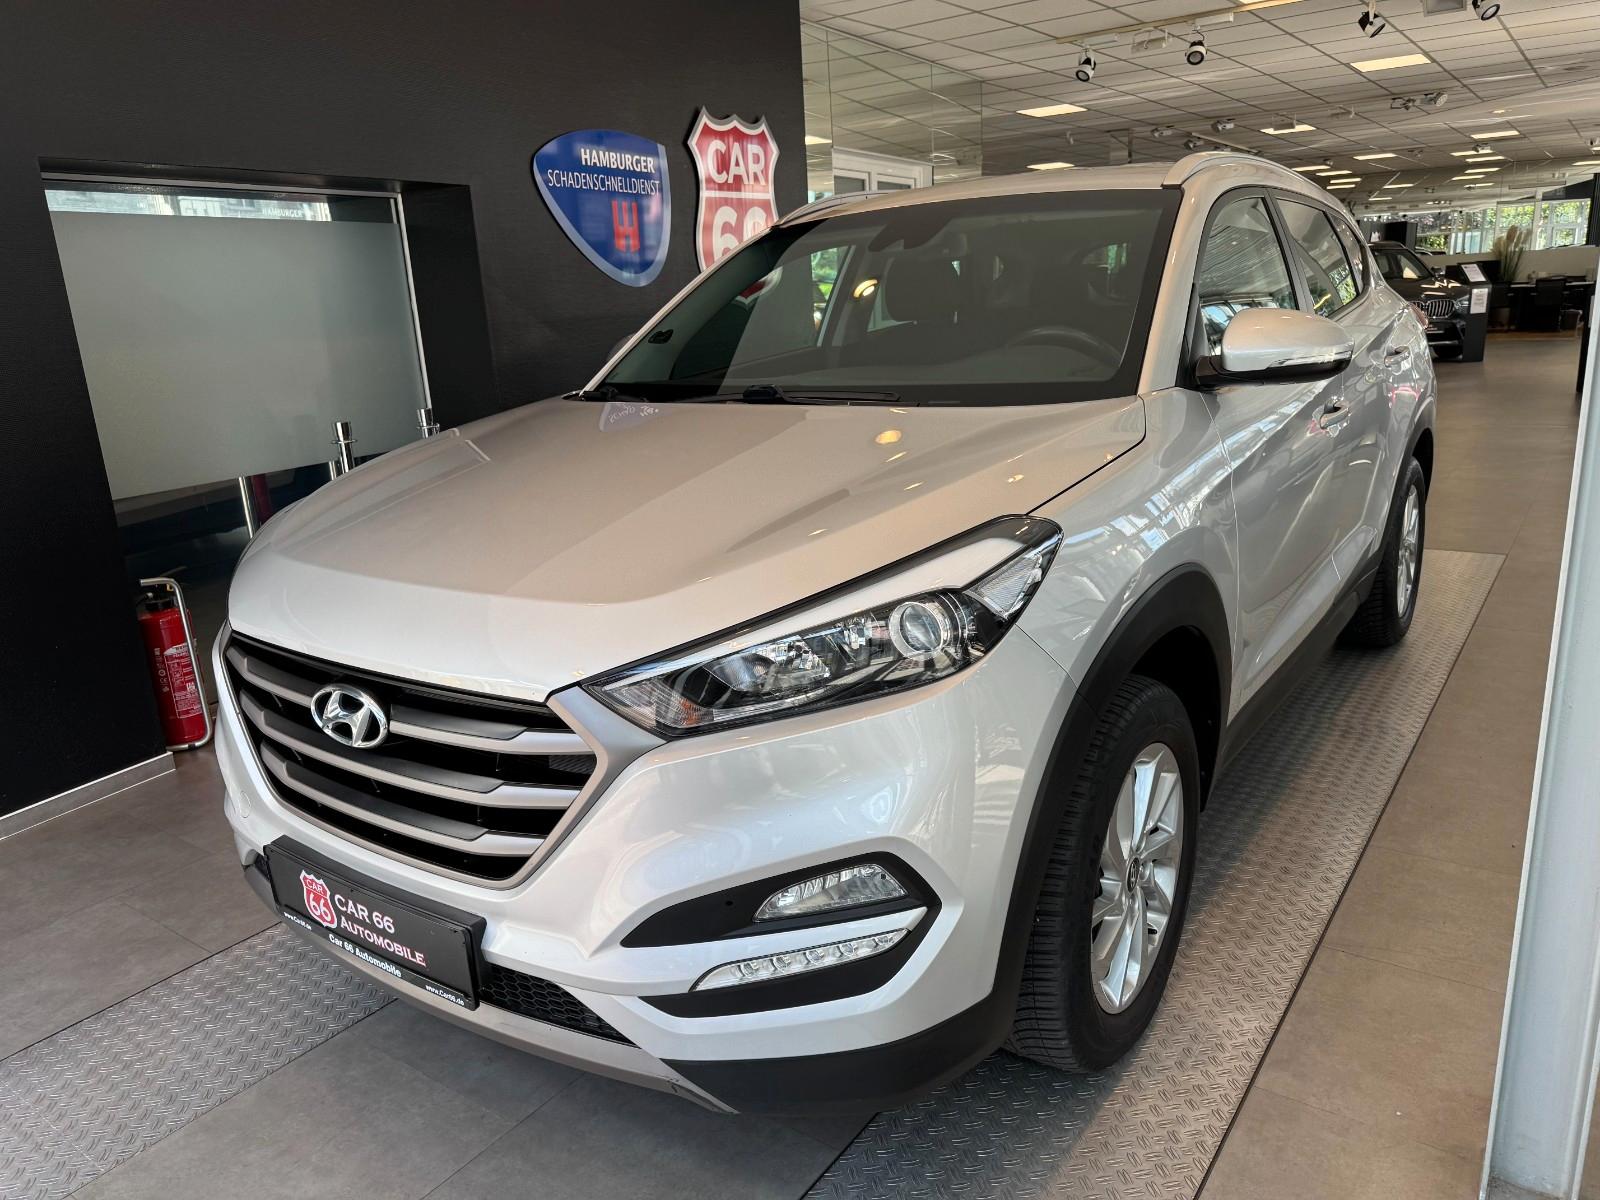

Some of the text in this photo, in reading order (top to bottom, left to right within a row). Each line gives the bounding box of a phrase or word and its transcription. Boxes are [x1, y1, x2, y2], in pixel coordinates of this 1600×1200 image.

[581, 148, 655, 173] HAMBURGER
[707, 140, 766, 185] CAR
[547, 169, 660, 196] SCHADENSCHNELLDIENST
[306, 879, 324, 895] CAR
[309, 893, 332, 921] 66
[334, 894, 395, 934] CAR 66
[329, 933, 402, 978] Car 66 Automobile
[340, 915, 426, 967] AUTOMOBILE
